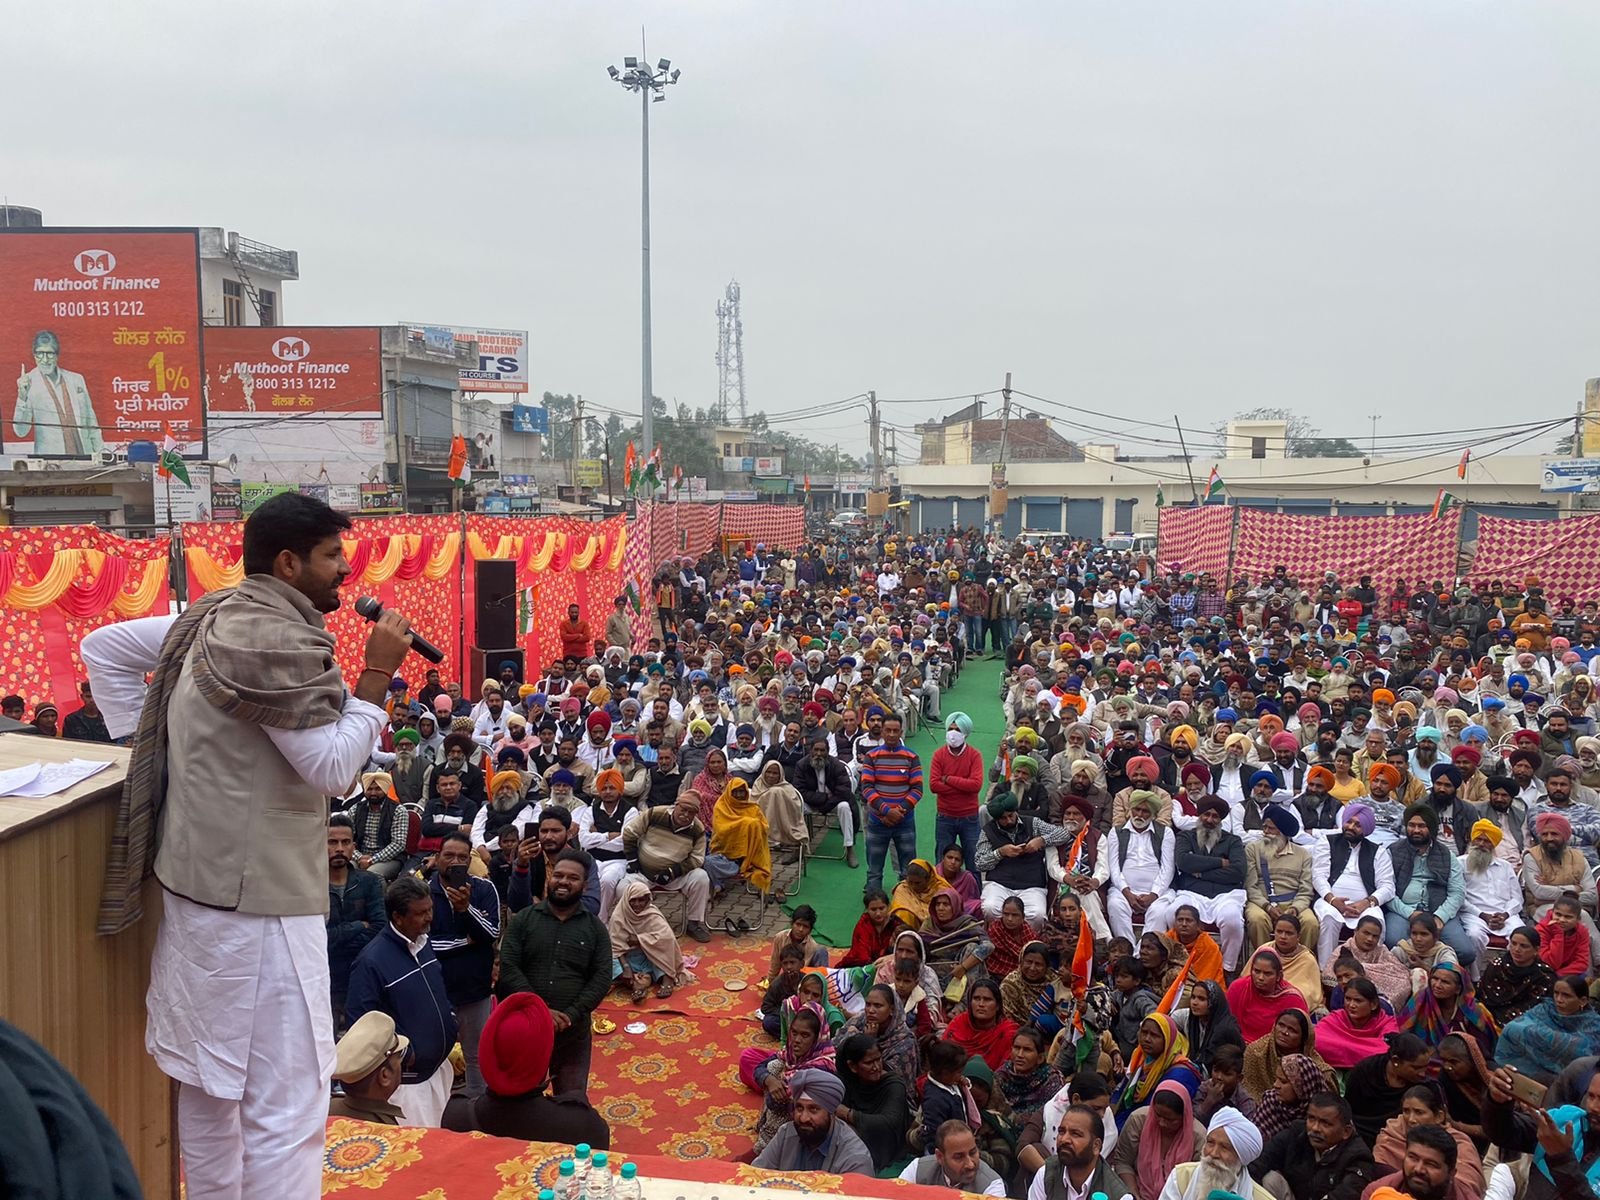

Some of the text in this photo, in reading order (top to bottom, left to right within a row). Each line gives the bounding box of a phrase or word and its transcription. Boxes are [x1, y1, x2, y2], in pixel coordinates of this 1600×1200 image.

[33, 276, 160, 291] Muthoot Finance
[52, 301, 145, 317] 1800 313 1212
[478, 335, 523, 346] BROTHERS
[233, 362, 350, 374] Muthoot Finance
[469, 372, 496, 380] COURSE
[281, 378, 304, 389] 313
[308, 378, 337, 389] 1212
